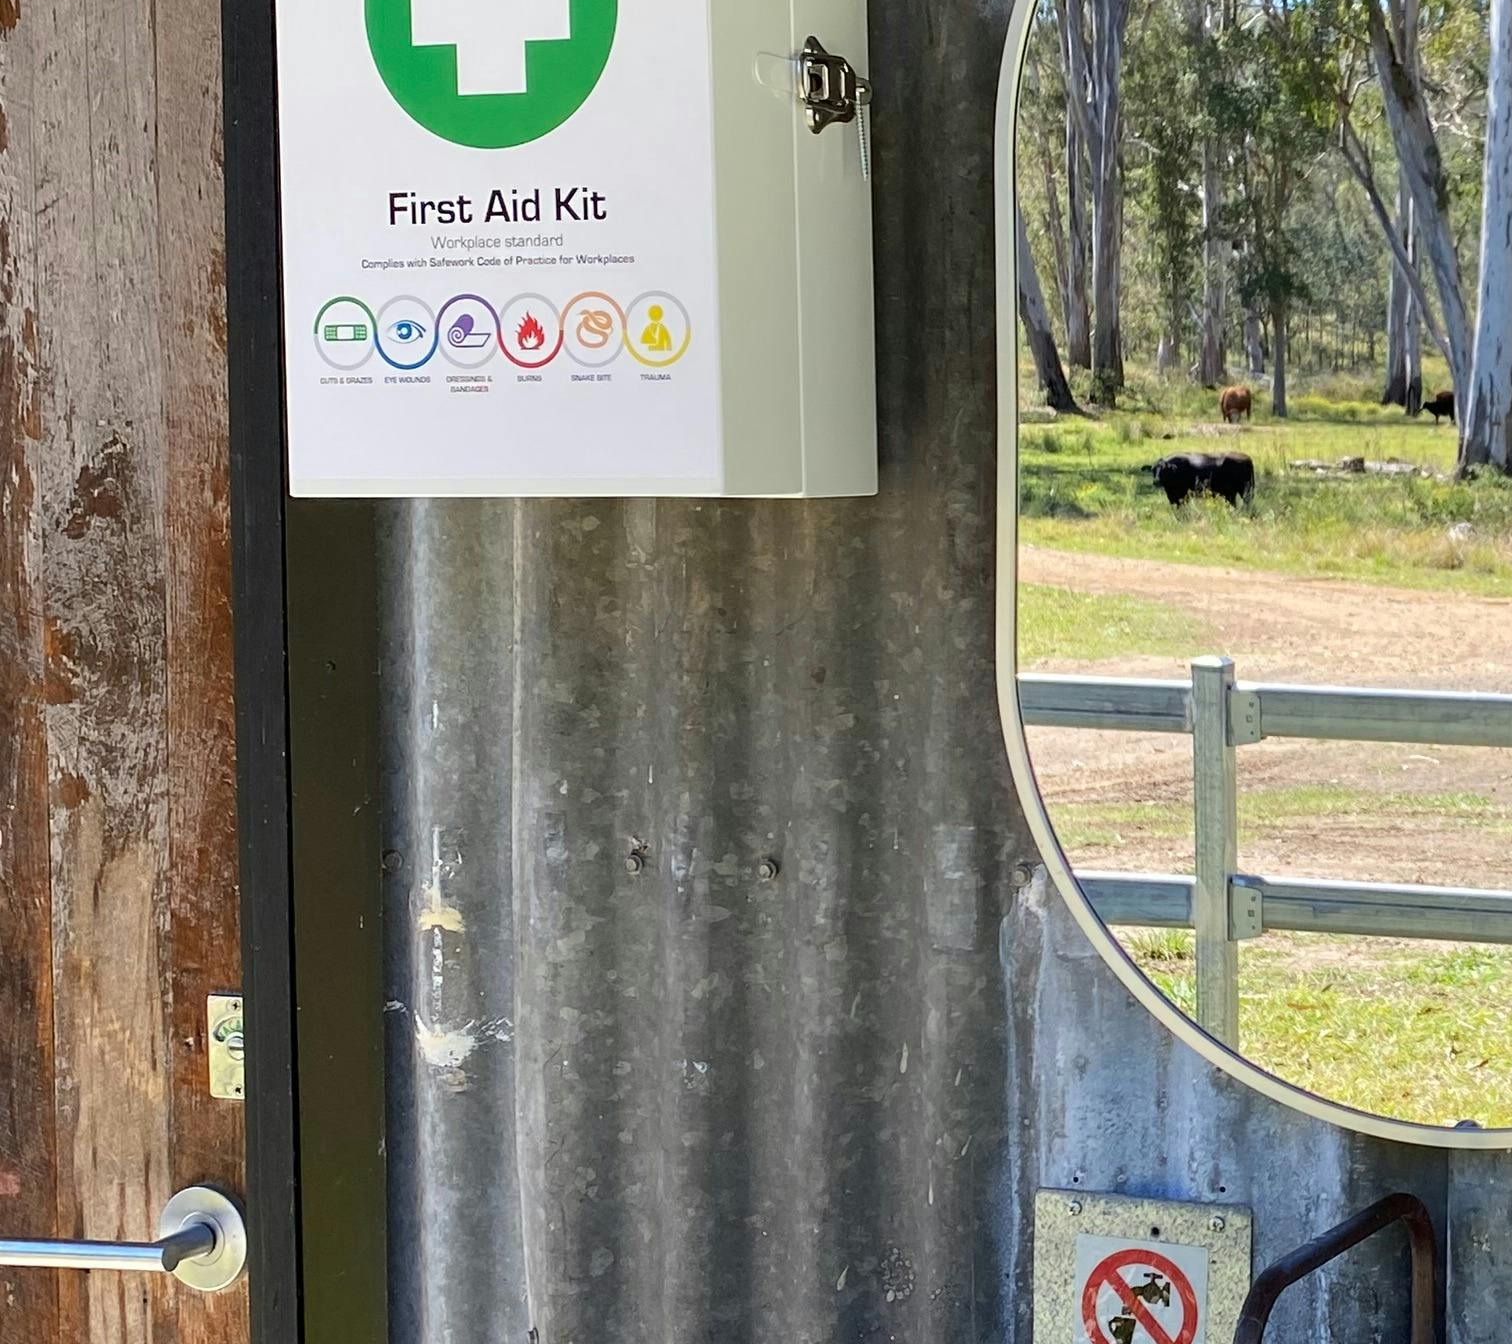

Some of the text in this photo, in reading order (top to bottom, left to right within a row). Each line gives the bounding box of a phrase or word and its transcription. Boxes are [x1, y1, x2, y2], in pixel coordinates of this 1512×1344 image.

[389, 187, 607, 226] First Aid Kit
[431, 234, 563, 251] Workplace standard
[361, 255, 635, 270] Complies with Safework Code of Practice for Workplaces
